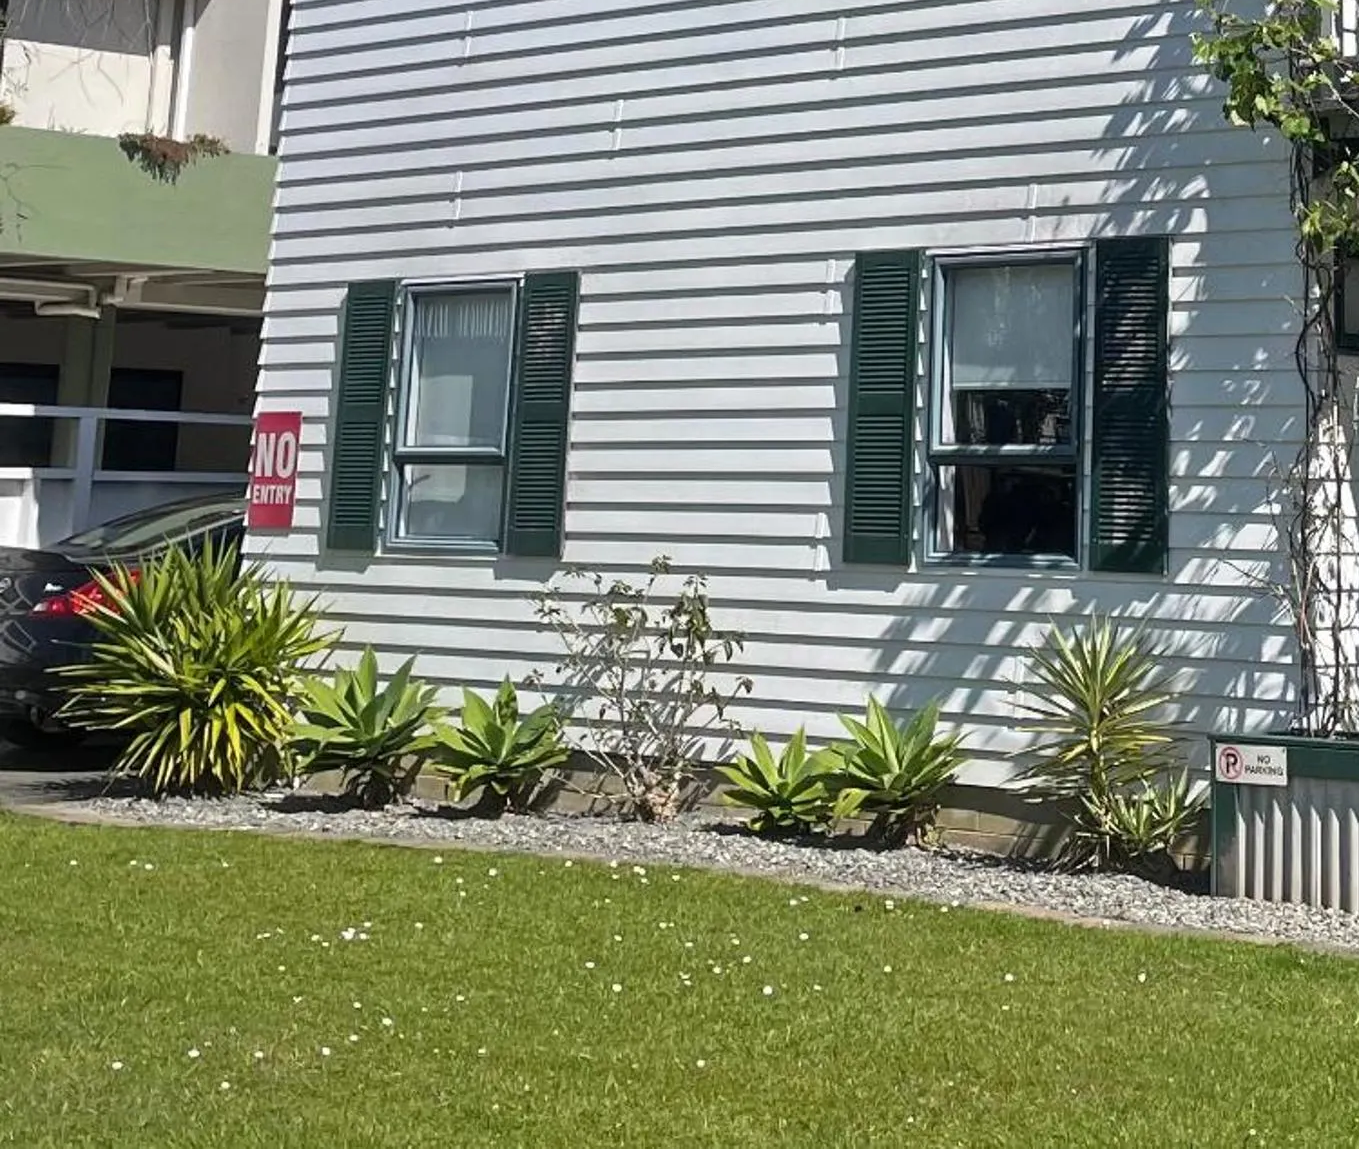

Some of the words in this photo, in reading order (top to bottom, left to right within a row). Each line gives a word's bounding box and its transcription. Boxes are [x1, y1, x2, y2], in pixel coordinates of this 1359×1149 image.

[255, 430, 297, 479] NO
[252, 484, 293, 505] ENTRY
[1256, 755, 1271, 764] NO
[1244, 764, 1284, 777] PARKING
